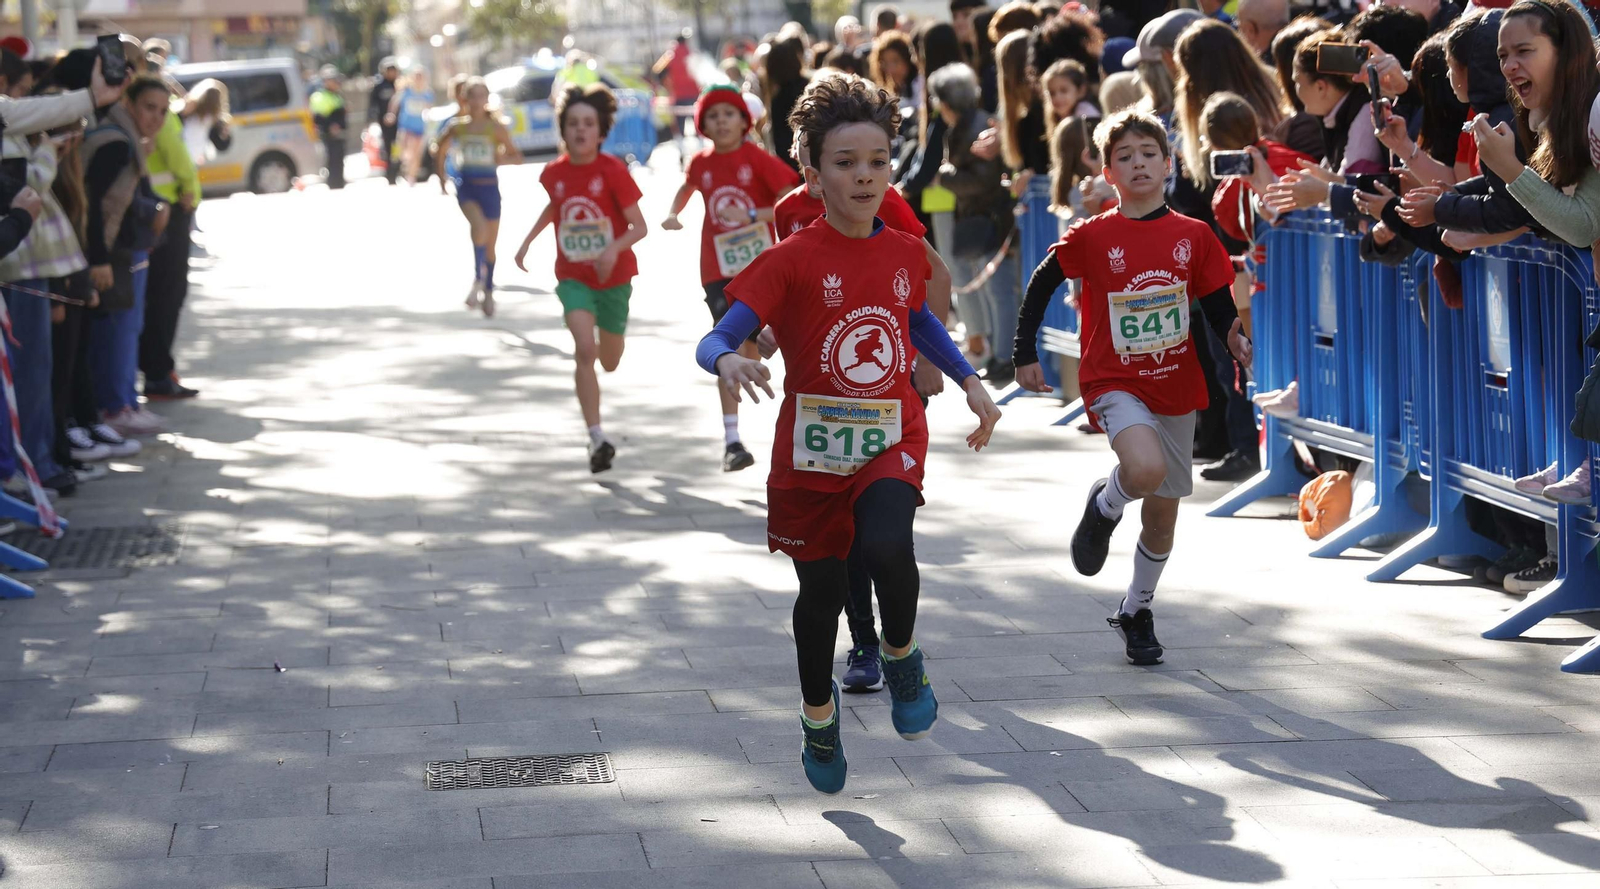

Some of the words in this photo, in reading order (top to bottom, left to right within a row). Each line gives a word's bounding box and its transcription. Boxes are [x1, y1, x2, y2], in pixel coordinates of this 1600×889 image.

[564, 233, 606, 251] 603
[723, 239, 764, 265] 632
[1110, 258, 1125, 267] UCA
[1132, 269, 1172, 285] SOLIDARIA
[824, 289, 843, 298] UCA
[845, 306, 891, 323] SOLIDARIA
[889, 315, 899, 330] DE
[1120, 307, 1182, 339] 641
[820, 319, 847, 362] CARRERA
[895, 328, 907, 373] NAVIDAD
[820, 363, 831, 373] XI
[1138, 364, 1179, 376] CUPRA
[830, 376, 853, 396] CIUDAD
[861, 379, 896, 397] ALGECIRAS
[817, 405, 849, 418] CARRERA
[850, 409, 881, 420] NAVIDAD
[805, 424, 887, 457] 618
